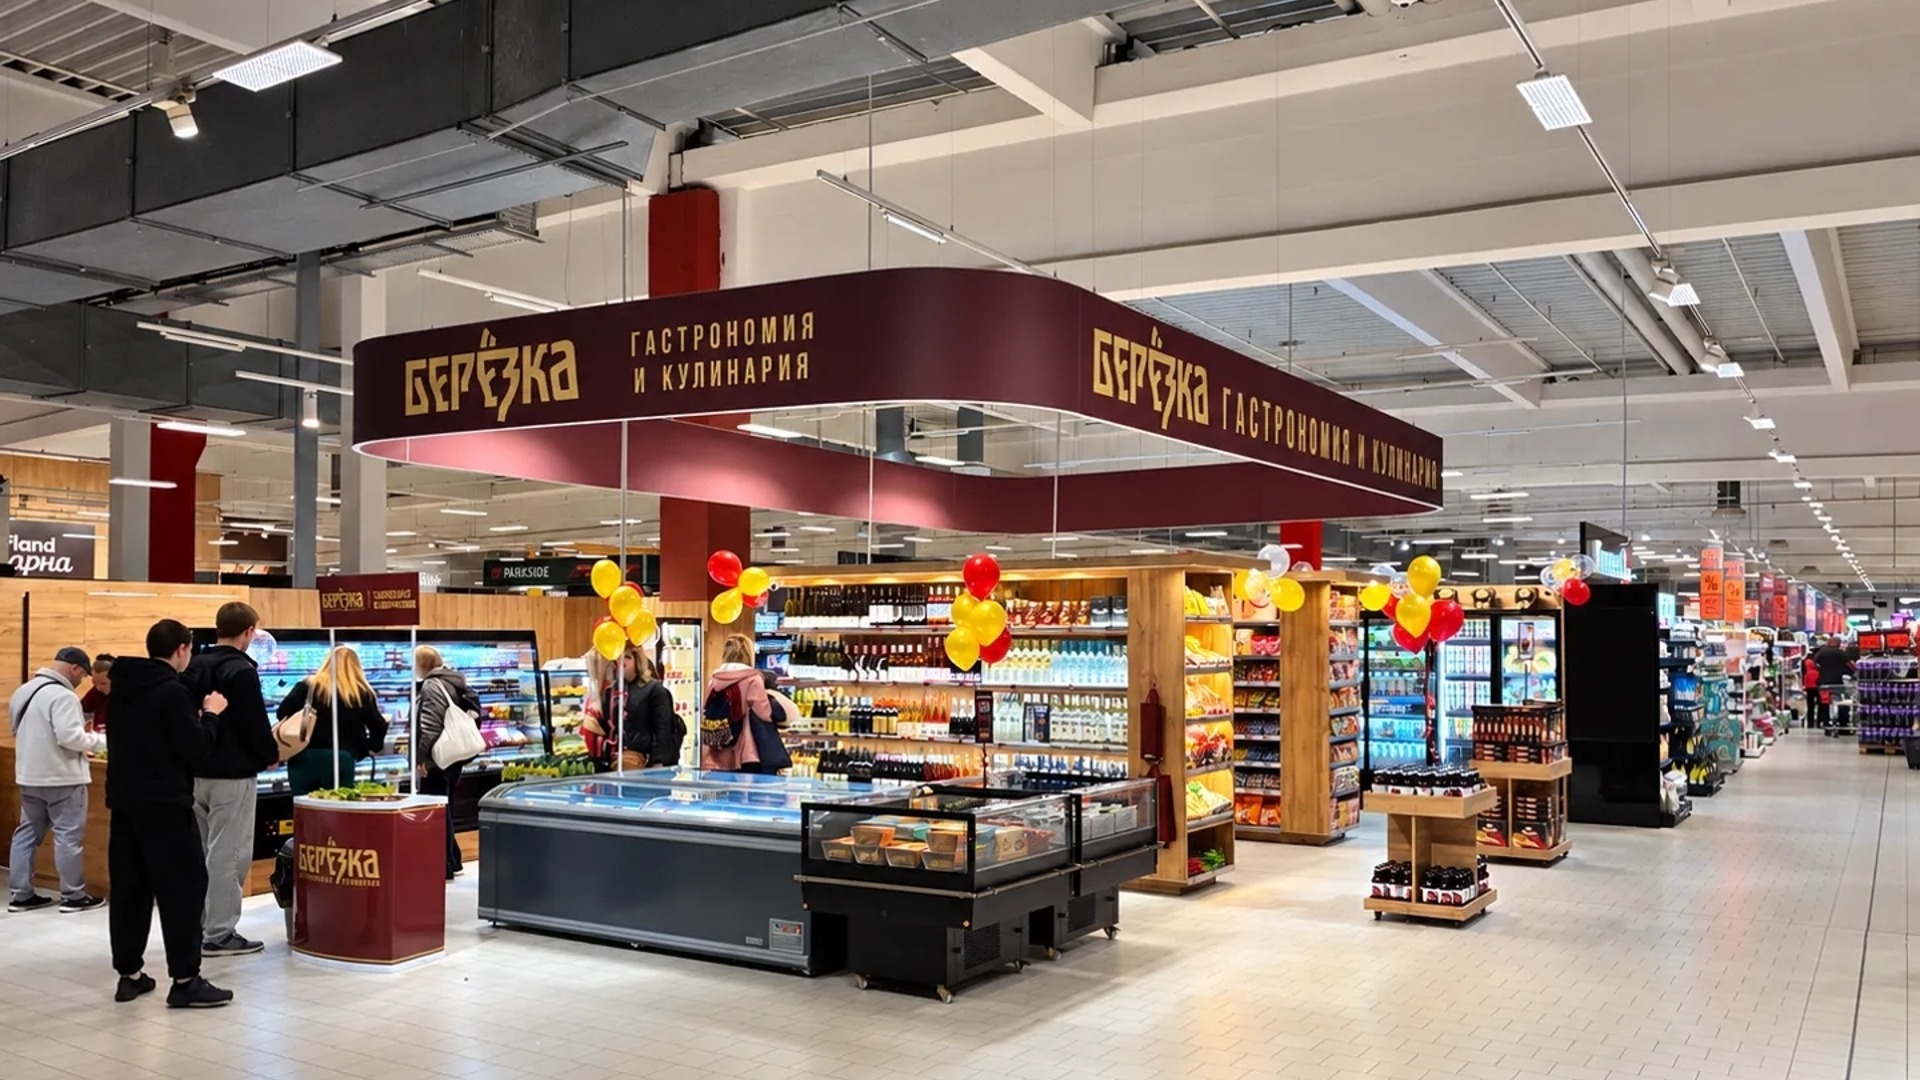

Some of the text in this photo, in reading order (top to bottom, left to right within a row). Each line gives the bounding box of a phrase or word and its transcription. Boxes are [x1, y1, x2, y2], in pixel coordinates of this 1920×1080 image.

[630, 311, 814, 358] ГАСТРОНОМИЯ
[633, 351, 809, 394] И КУЛИНАРИЯ
[1222, 386, 1438, 490] ГАСТРОНОМИЯ И КУЛИНАРИЯ
[503, 565, 550, 579] PARKSIDE
